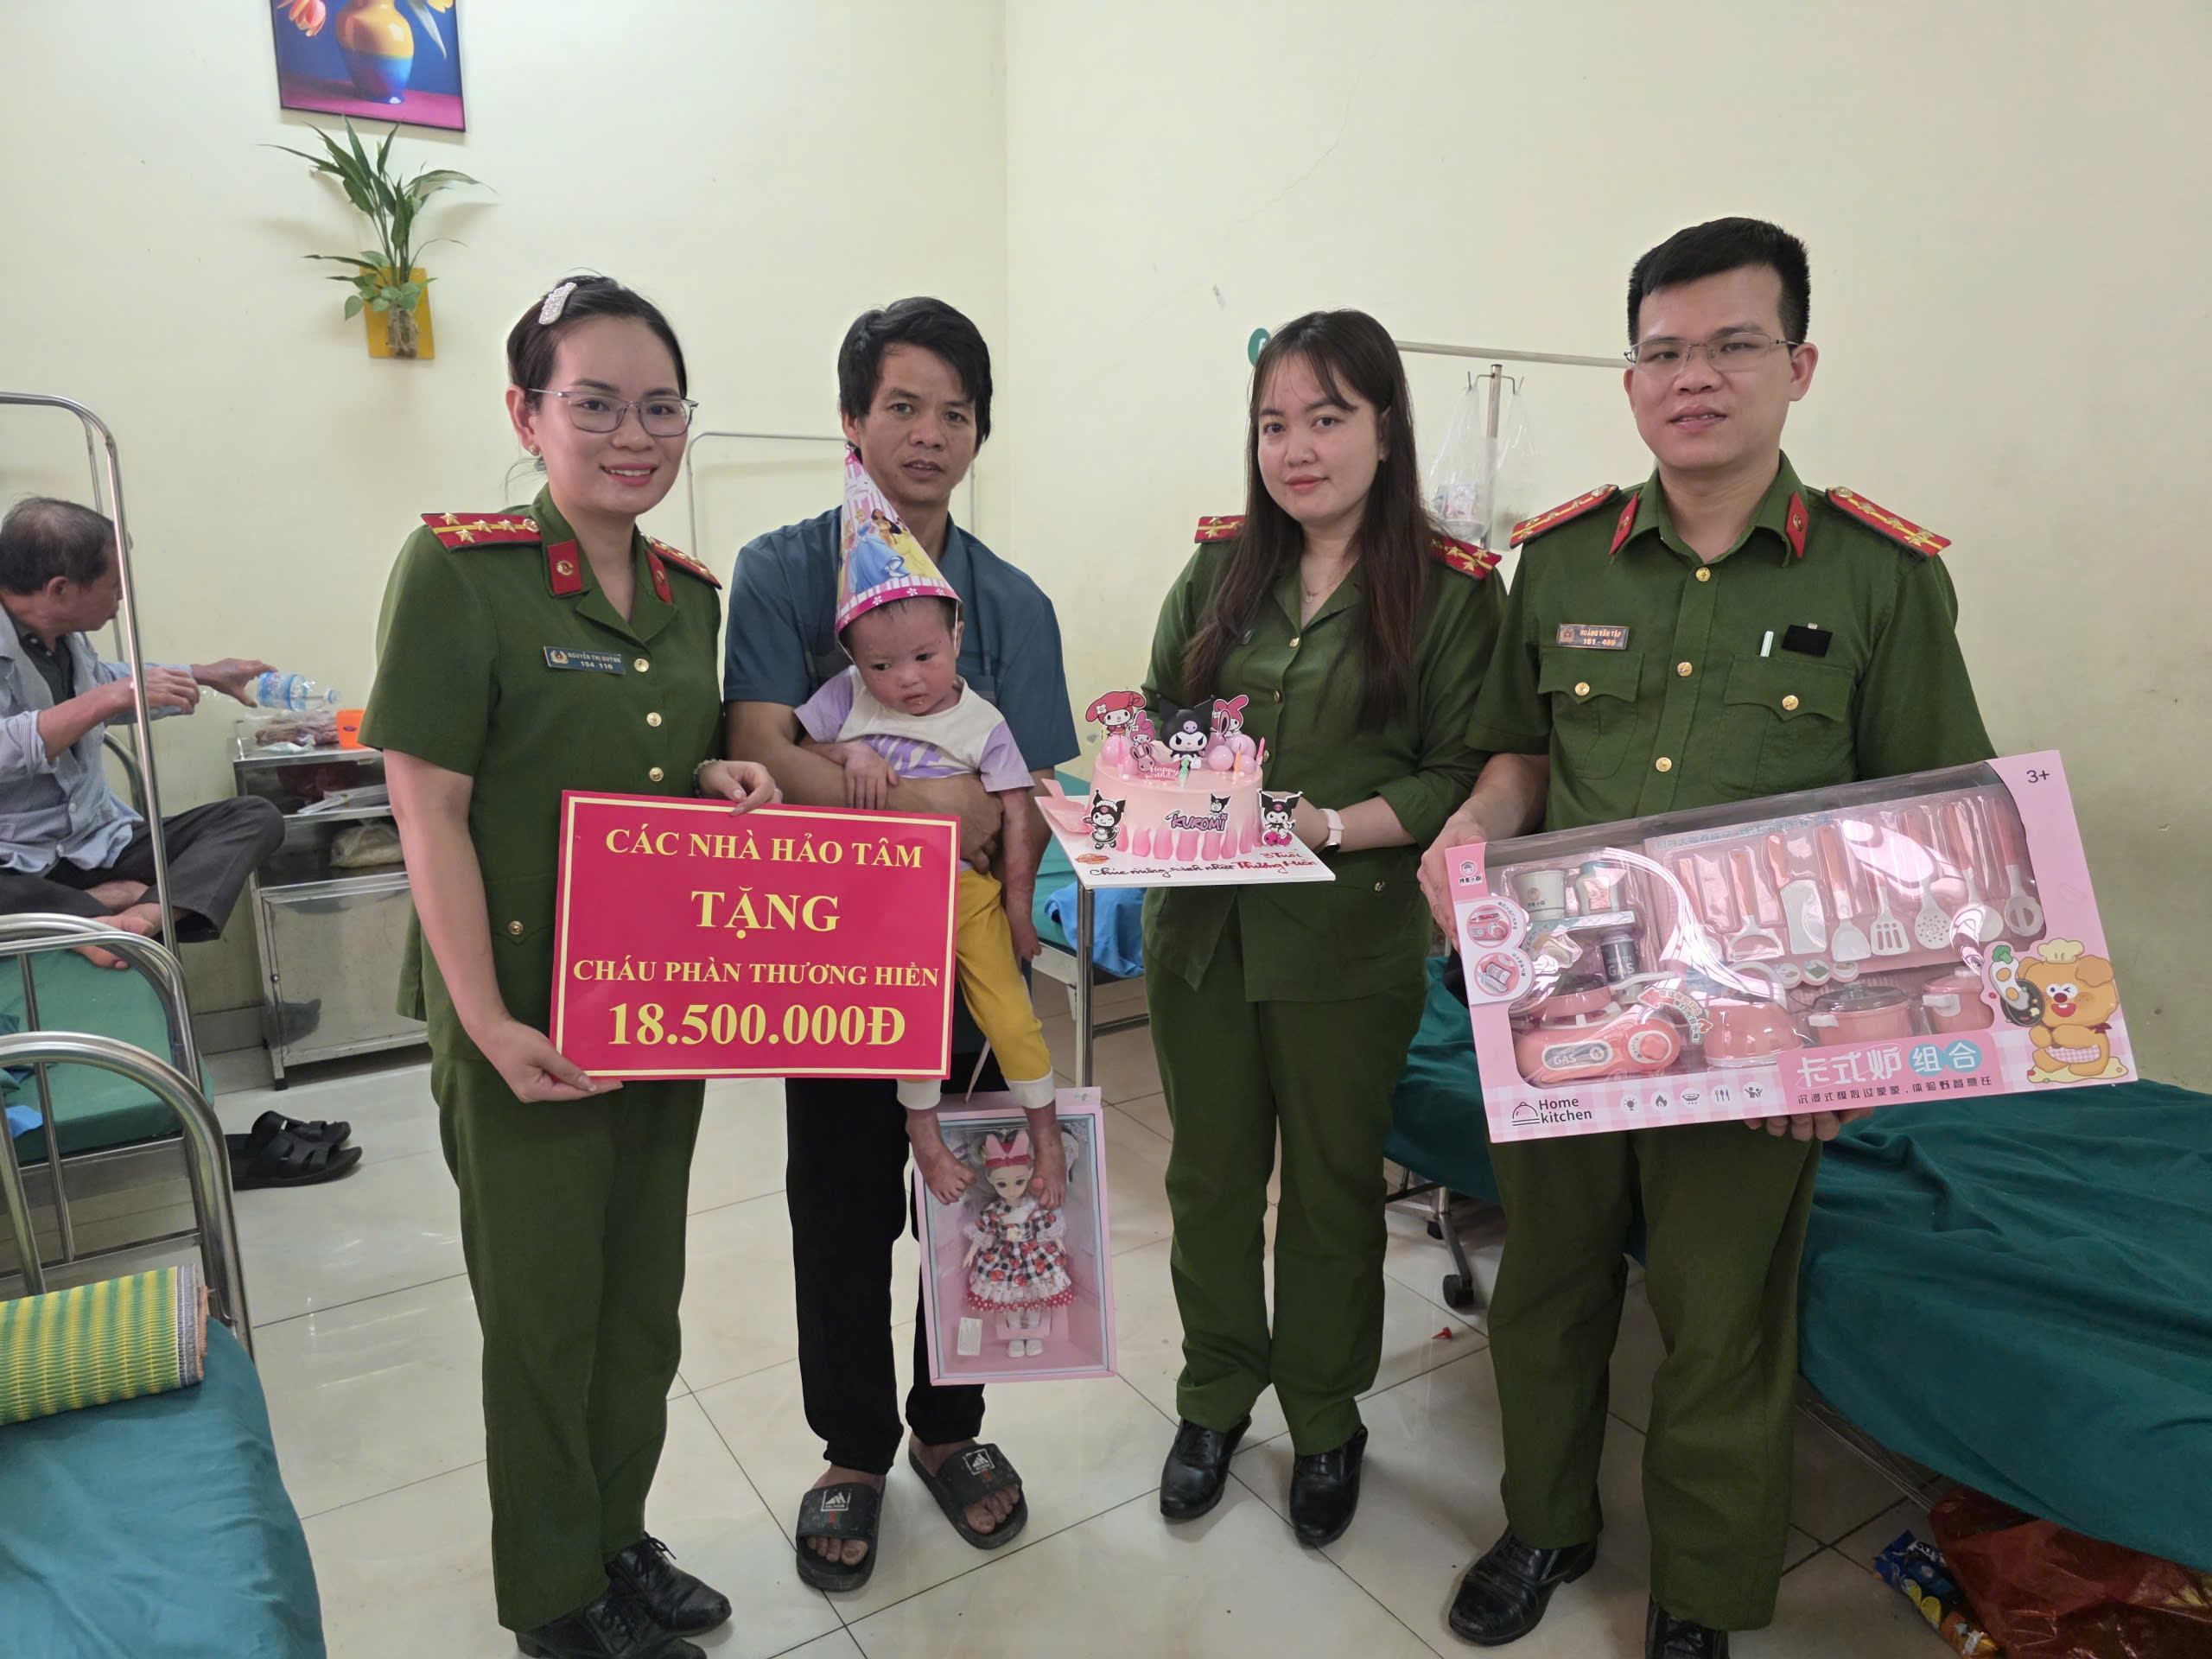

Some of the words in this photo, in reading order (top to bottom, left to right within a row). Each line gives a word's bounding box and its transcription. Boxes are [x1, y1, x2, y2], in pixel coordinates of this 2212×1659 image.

[2026, 769, 2050, 784] 3+
[606, 823, 679, 855] CÁC
[690, 830, 760, 860] NHÀ
[772, 833, 843, 864] HẢO
[852, 837, 924, 868] TÂM
[691, 886, 841, 939] TẶNG
[573, 955, 658, 982] CHÁU
[664, 957, 742, 982] PHÀN
[748, 961, 868, 986] THƯƠNG
[874, 961, 940, 987] HIỀN
[607, 1001, 906, 1046] 18.500.000Đ
[1538, 1098, 1580, 1111] Home
[1541, 1109, 1592, 1124] kitchen
